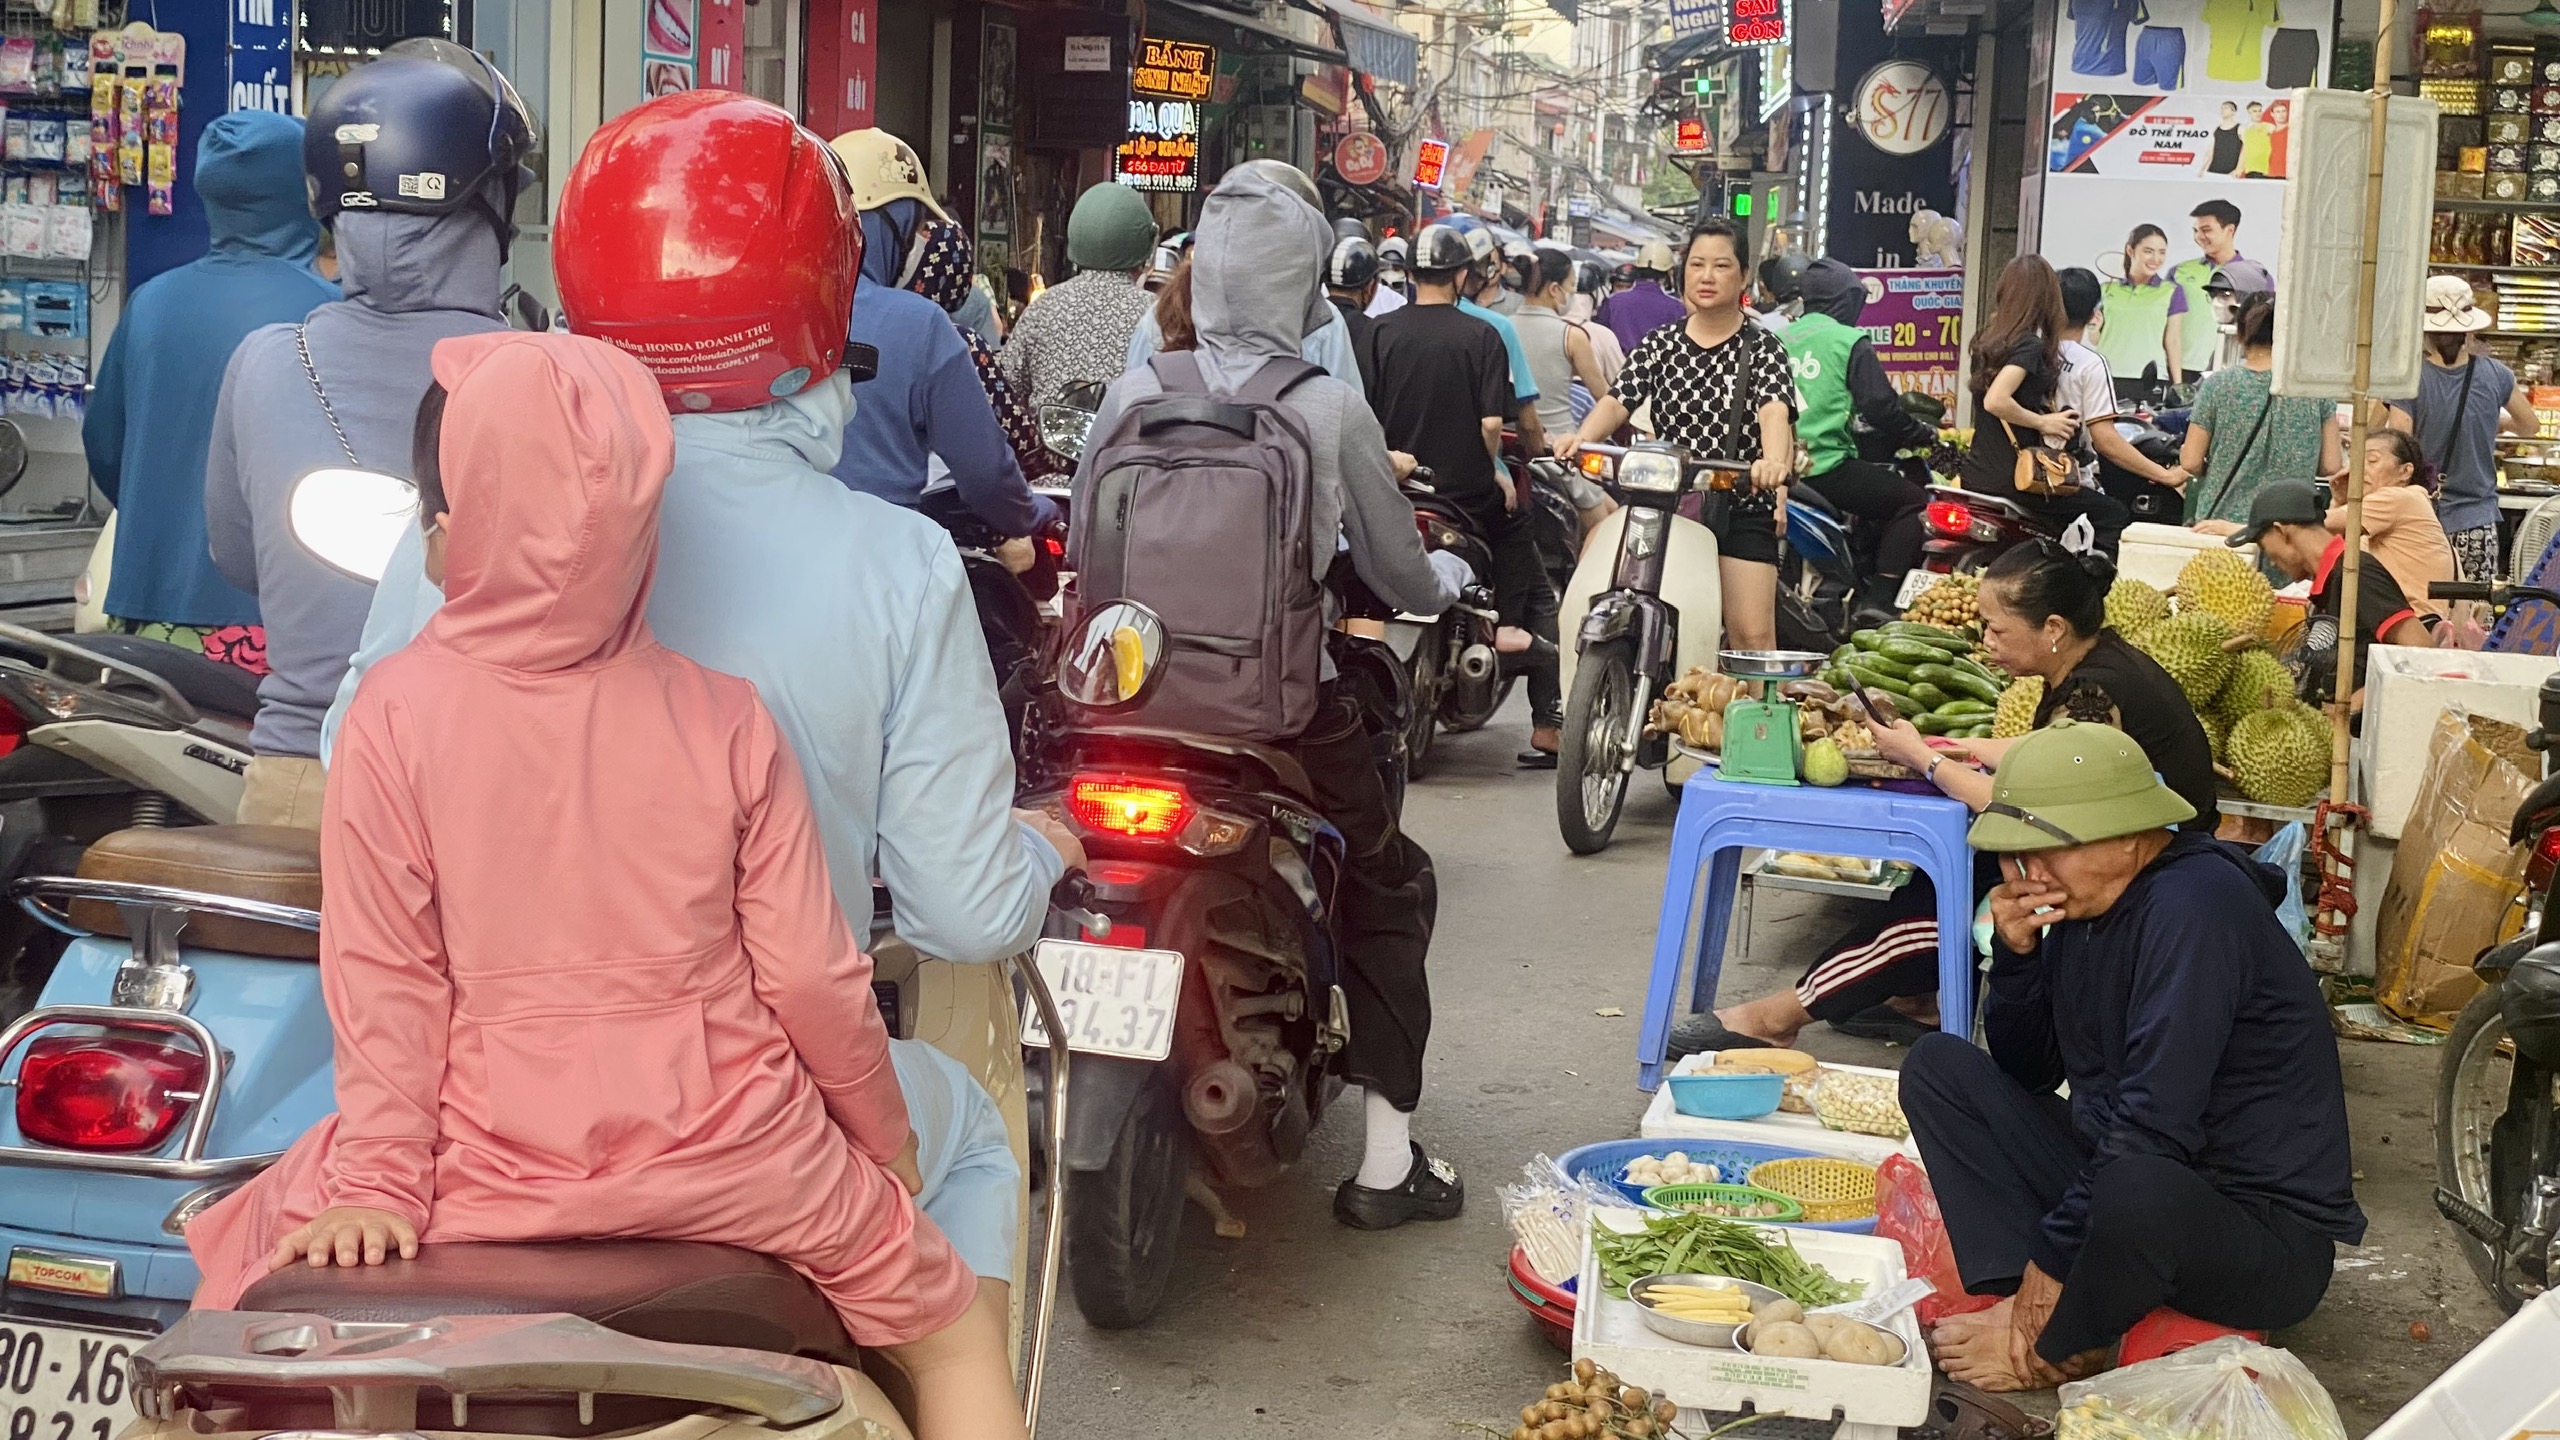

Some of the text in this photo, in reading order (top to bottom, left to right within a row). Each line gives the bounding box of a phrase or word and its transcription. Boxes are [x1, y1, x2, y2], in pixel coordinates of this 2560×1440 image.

[1731, 17, 1783, 41] GÒN
[1136, 67, 1210, 99] SINH NHẬT
[2129, 124, 2148, 136] ĐỒ
[2176, 129, 2209, 138] THAO
[2154, 140, 2183, 149] NAM
[1854, 191, 1927, 214] Made
[1876, 247, 1900, 268] in
[1943, 298, 1960, 307] GIA
[615, 339, 643, 353] thống
[645, 342, 693, 353] HONDA
[696, 333, 743, 350] DOANH
[745, 322, 771, 338] THU
[1893, 322, 1916, 347] 20
[34, 1265, 82, 1282] TOPCOM
